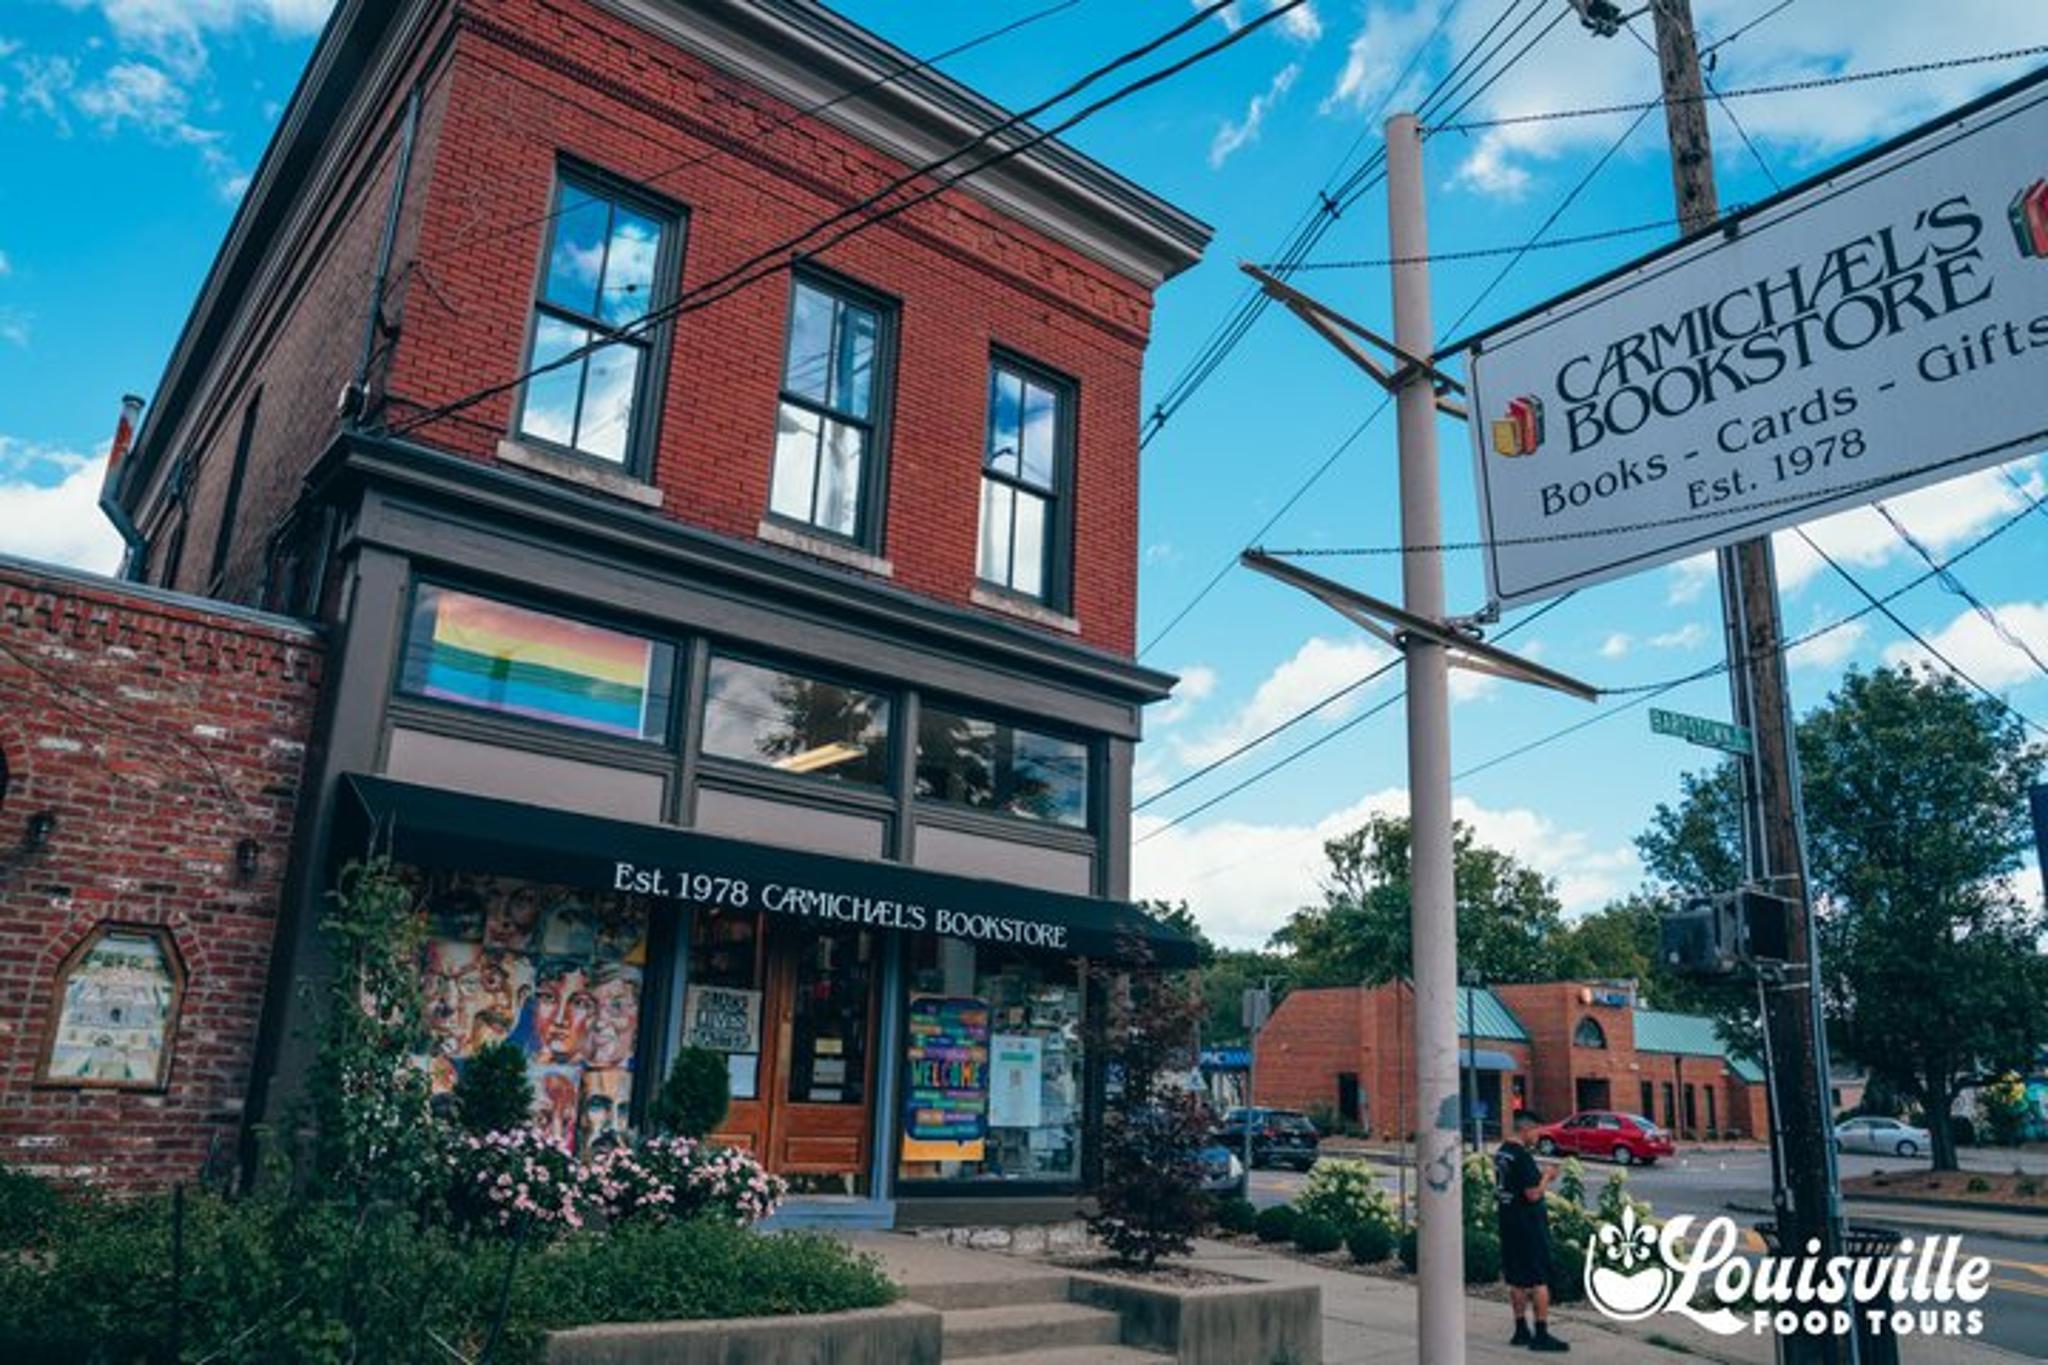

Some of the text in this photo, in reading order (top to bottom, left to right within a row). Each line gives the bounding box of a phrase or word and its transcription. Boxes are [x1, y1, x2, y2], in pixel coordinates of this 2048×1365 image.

[1564, 248, 1995, 455] BOOKSTORE
[1539, 446, 1668, 518] Books
[1716, 385, 1859, 454] Cards
[1917, 313, 2048, 383] Gifts
[1687, 428, 1868, 510] Est. 1978
[614, 861, 670, 895] Est.
[679, 872, 750, 907] 1978
[935, 909, 1067, 949] BOOKSTORE
[911, 1059, 981, 1088] WELCOME
